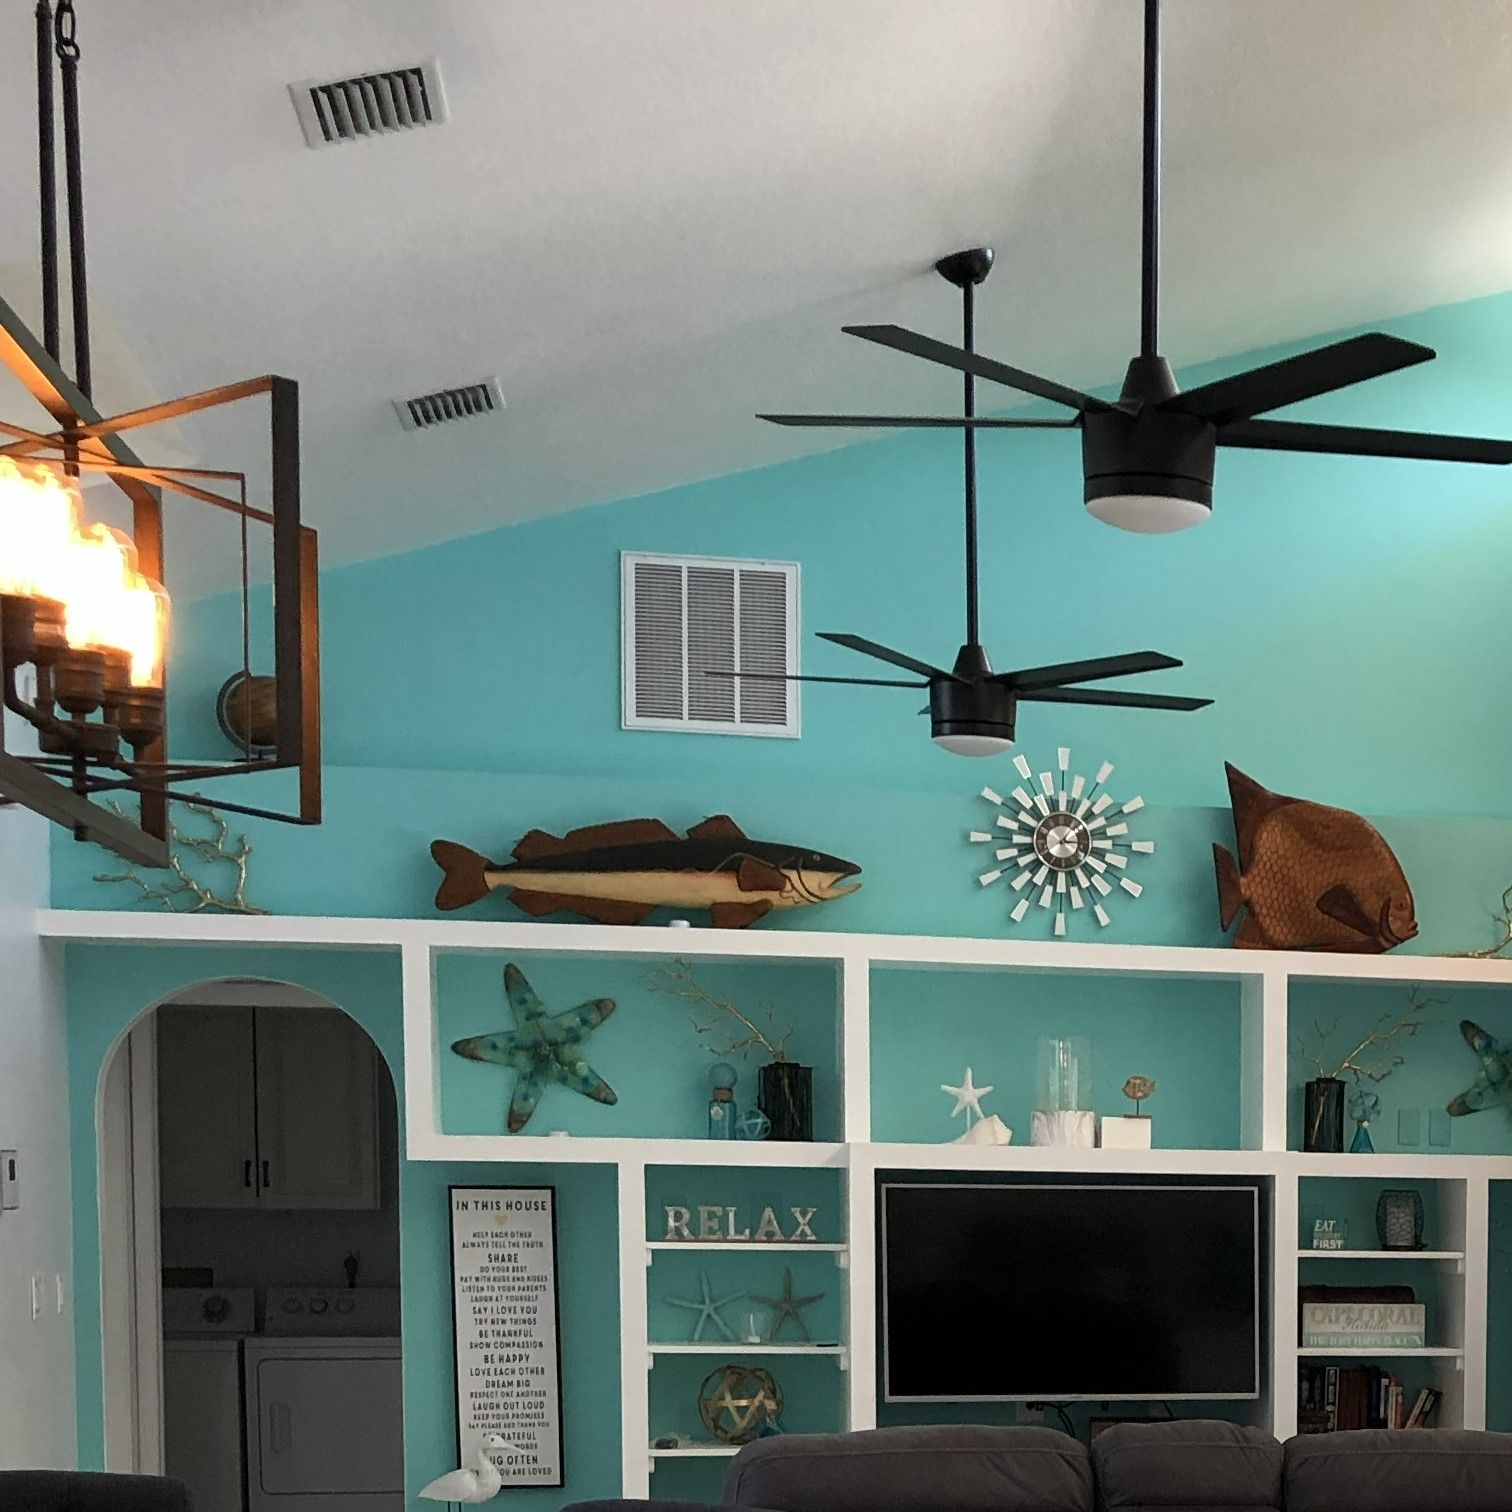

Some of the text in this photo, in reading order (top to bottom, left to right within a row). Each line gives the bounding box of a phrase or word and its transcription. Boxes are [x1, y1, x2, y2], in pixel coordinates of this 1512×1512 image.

[456, 1201, 547, 1211] IN THIS HOUSE
[665, 1206, 818, 1240] RELAX
[1315, 1219, 1337, 1232] EAT
[472, 1231, 489, 1239] HELP
[491, 1231, 508, 1239] EACH
[462, 1241, 489, 1249] ALWAYS
[1313, 1239, 1344, 1249] FIRST
[488, 1253, 519, 1263] SHARE
[512, 1265, 527, 1273] BEST
[462, 1285, 484, 1293] LISTEN
[505, 1294, 539, 1302] YOURSELF
[473, 1306, 488, 1315] SAY
[496, 1305, 518, 1315] LOVE
[520, 1305, 538, 1315] YOU
[474, 1318, 488, 1326] TRY
[510, 1317, 537, 1325] THINGS
[479, 1329, 533, 1338] BE THANKFUL
[469, 1341, 544, 1349] SHOW COMPASSION
[484, 1353, 530, 1364] BE HAPPY
[470, 1366, 545, 1377] LOVE EACH OTHER
[485, 1380, 531, 1388] DREAM BIG
[470, 1391, 499, 1399] RESPECT
[516, 1390, 547, 1398] ANOTHER
[473, 1401, 545, 1411] LAUGH OUT LOUD
[511, 1411, 545, 1420] PROMISES
[489, 1455, 538, 1465] UG OFTEN
[512, 1468, 526, 1476] ARE
[528, 1467, 552, 1475] LOVED
